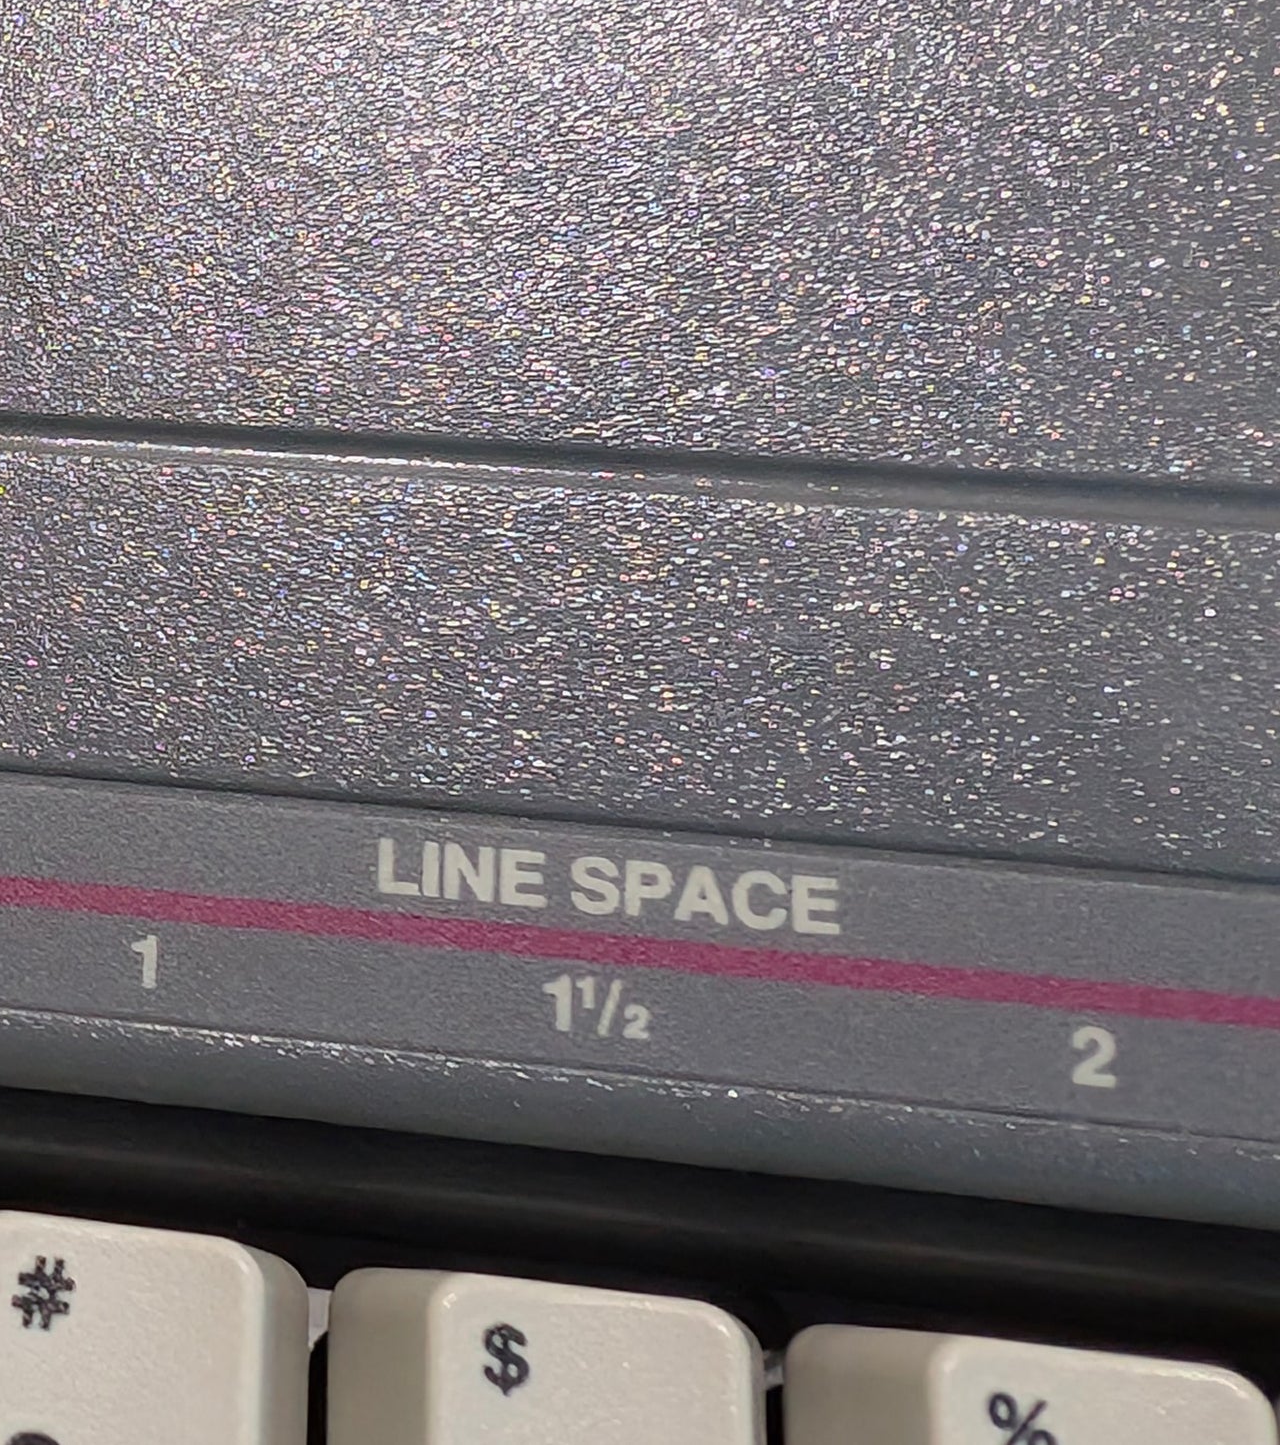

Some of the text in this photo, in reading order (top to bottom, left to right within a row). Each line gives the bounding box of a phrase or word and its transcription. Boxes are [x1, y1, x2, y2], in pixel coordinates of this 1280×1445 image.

[377, 837, 841, 935] LINE SPACE
[130, 934, 158, 989] 1
[1071, 1025, 1117, 1088] 2
[11, 1255, 76, 1331] #
[483, 1323, 530, 1396] $
